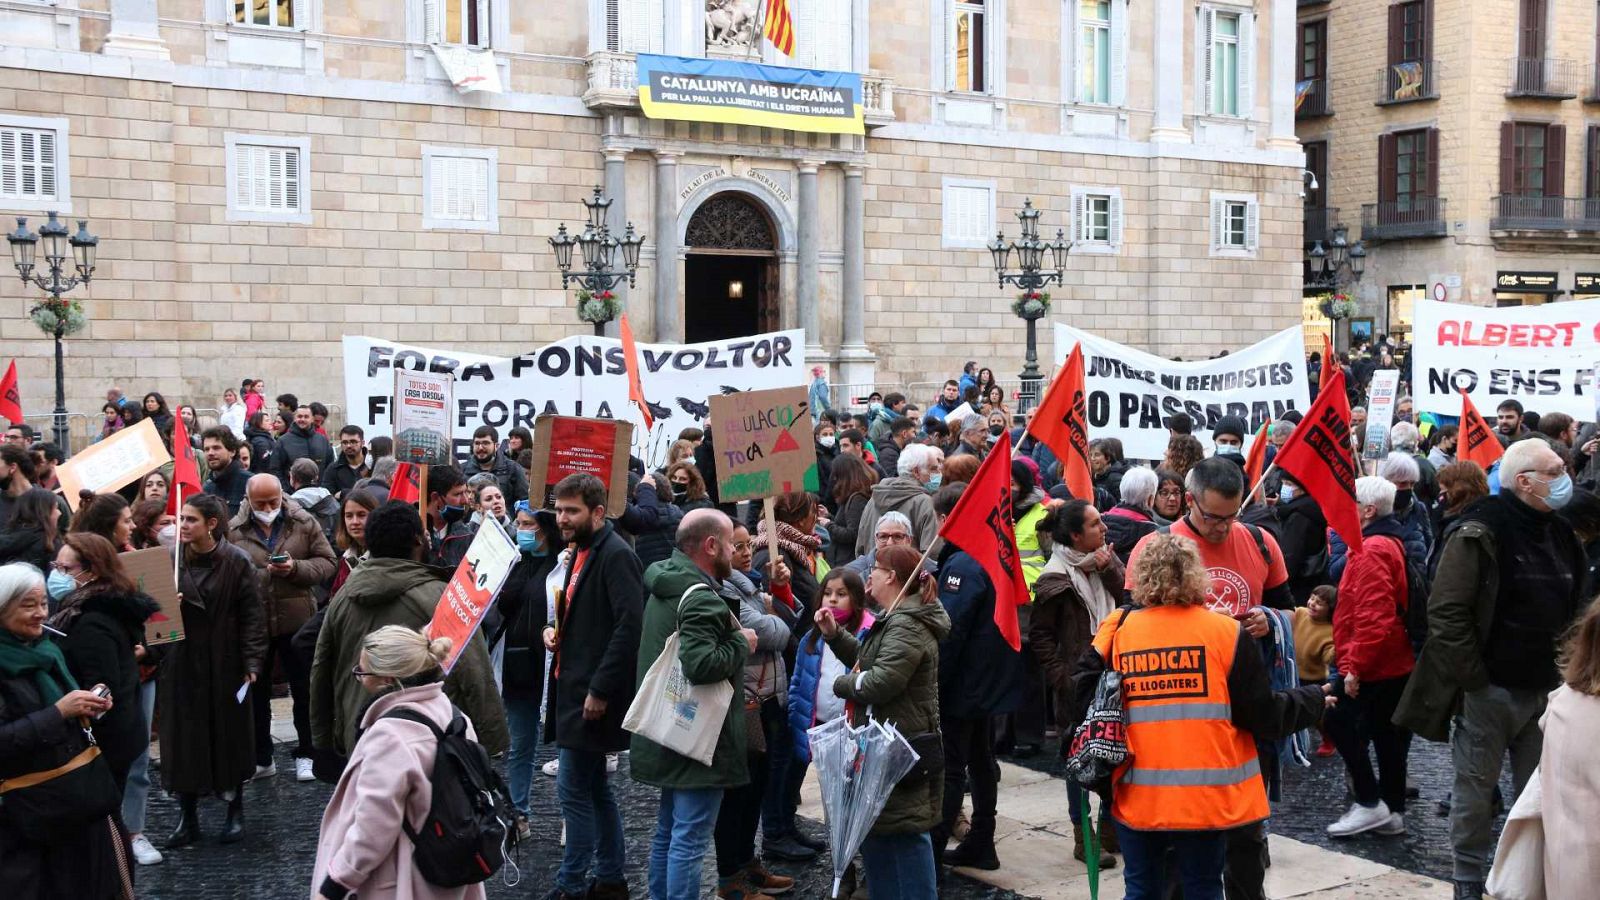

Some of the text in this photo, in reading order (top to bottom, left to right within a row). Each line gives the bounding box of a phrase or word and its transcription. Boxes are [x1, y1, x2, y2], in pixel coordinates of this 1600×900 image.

[660, 76, 844, 103] CATALUNYA AMB UCRAÏNA
[661, 92, 679, 100] PER
[680, 94, 691, 102] LA
[692, 95, 712, 104] PAU,
[713, 96, 725, 104] LA
[726, 97, 765, 108] LLIBERTAT
[770, 102, 784, 110] ELS
[785, 104, 810, 113] DRETS
[811, 106, 845, 115] HUMANS
[681, 168, 792, 202] PALAU DE LA GENERALITAT
[1436, 320, 1581, 347] ALBERT
[367, 335, 793, 382] FORA FONS VOLTOR
[409, 380, 427, 390] TOTES
[1160, 372, 1181, 391] NI
[1185, 361, 1294, 392] RENDISTES
[1428, 367, 1479, 395] NO
[1488, 368, 1561, 396] ENS
[404, 388, 445, 400] CASA ORSOLA
[724, 442, 763, 468] TOCA
[947, 575, 961, 586] HH
[1121, 650, 1200, 675] SINDICAT
[1125, 678, 1198, 693] DE LLOGATERS
